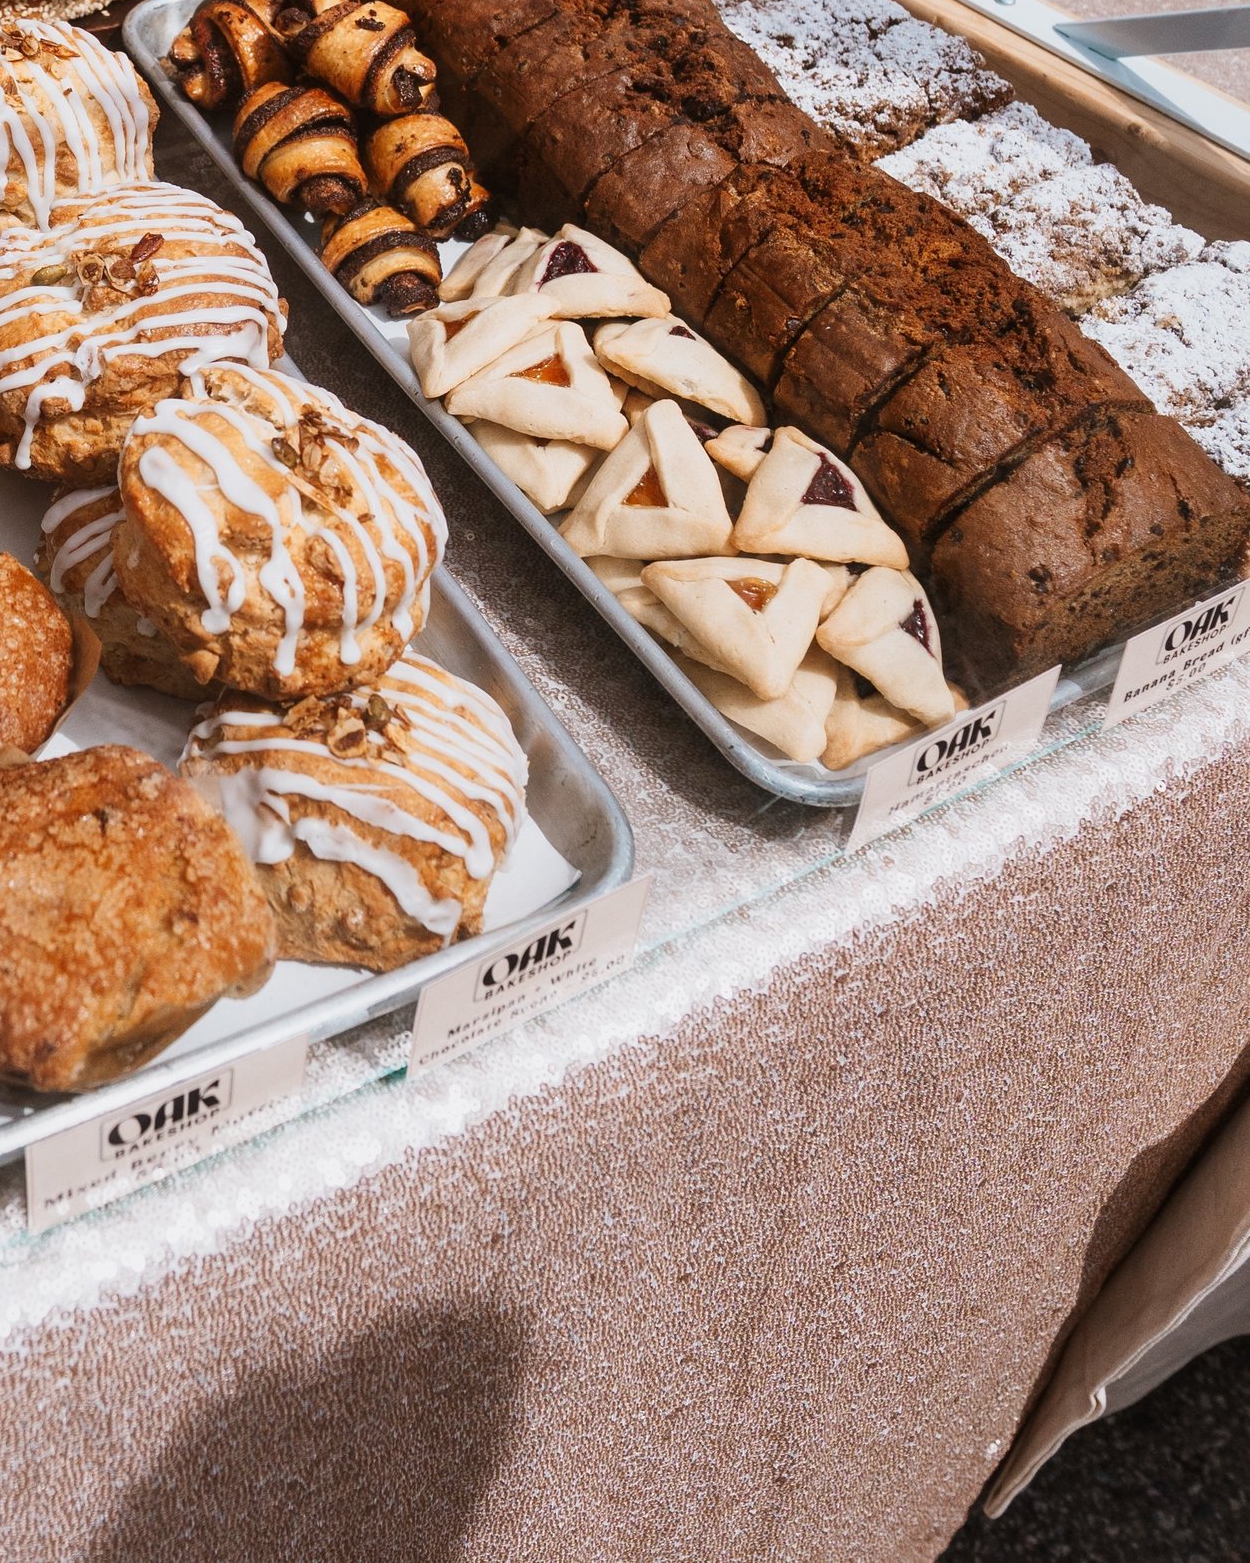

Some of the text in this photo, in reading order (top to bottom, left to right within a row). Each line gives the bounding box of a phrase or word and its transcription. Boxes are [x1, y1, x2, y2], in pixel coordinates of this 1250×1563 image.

[1163, 624, 1227, 665] BAKESHOP
[1165, 596, 1236, 652] OAK
[1124, 669, 1176, 703] Banana
[1183, 641, 1225, 671] Bread
[916, 709, 997, 773] OAK
[916, 738, 990, 786] BAKESHOP
[482, 919, 577, 988] OAK
[484, 949, 572, 1001] BAKESHOP
[447, 994, 525, 1039] Marzipan
[550, 956, 597, 986] White
[419, 1018, 502, 1066] Chocolate
[107, 1078, 220, 1146] OAK
[114, 1107, 221, 1159] BAKESHOP
